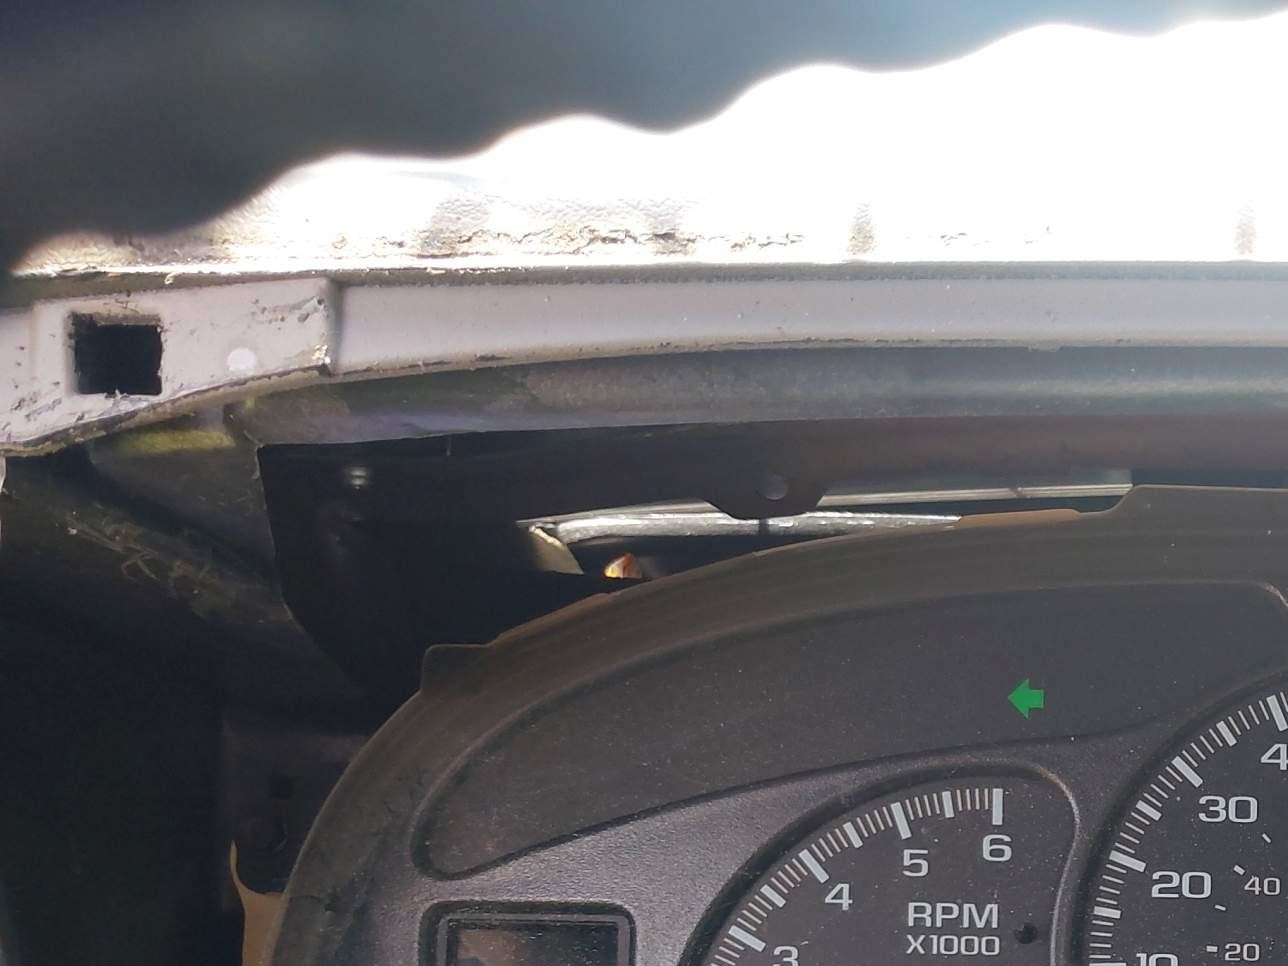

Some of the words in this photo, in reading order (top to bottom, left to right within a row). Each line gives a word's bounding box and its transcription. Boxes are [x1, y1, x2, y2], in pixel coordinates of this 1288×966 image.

[1198, 796, 1258, 823] 30
[982, 834, 1012, 862] 6
[902, 849, 929, 877] 5
[825, 883, 853, 911] 4
[1151, 871, 1212, 898] 20
[1244, 877, 1281, 896] 40
[907, 902, 999, 929] RPM
[905, 935, 1000, 956] X1000
[1224, 943, 1260, 962] 20
